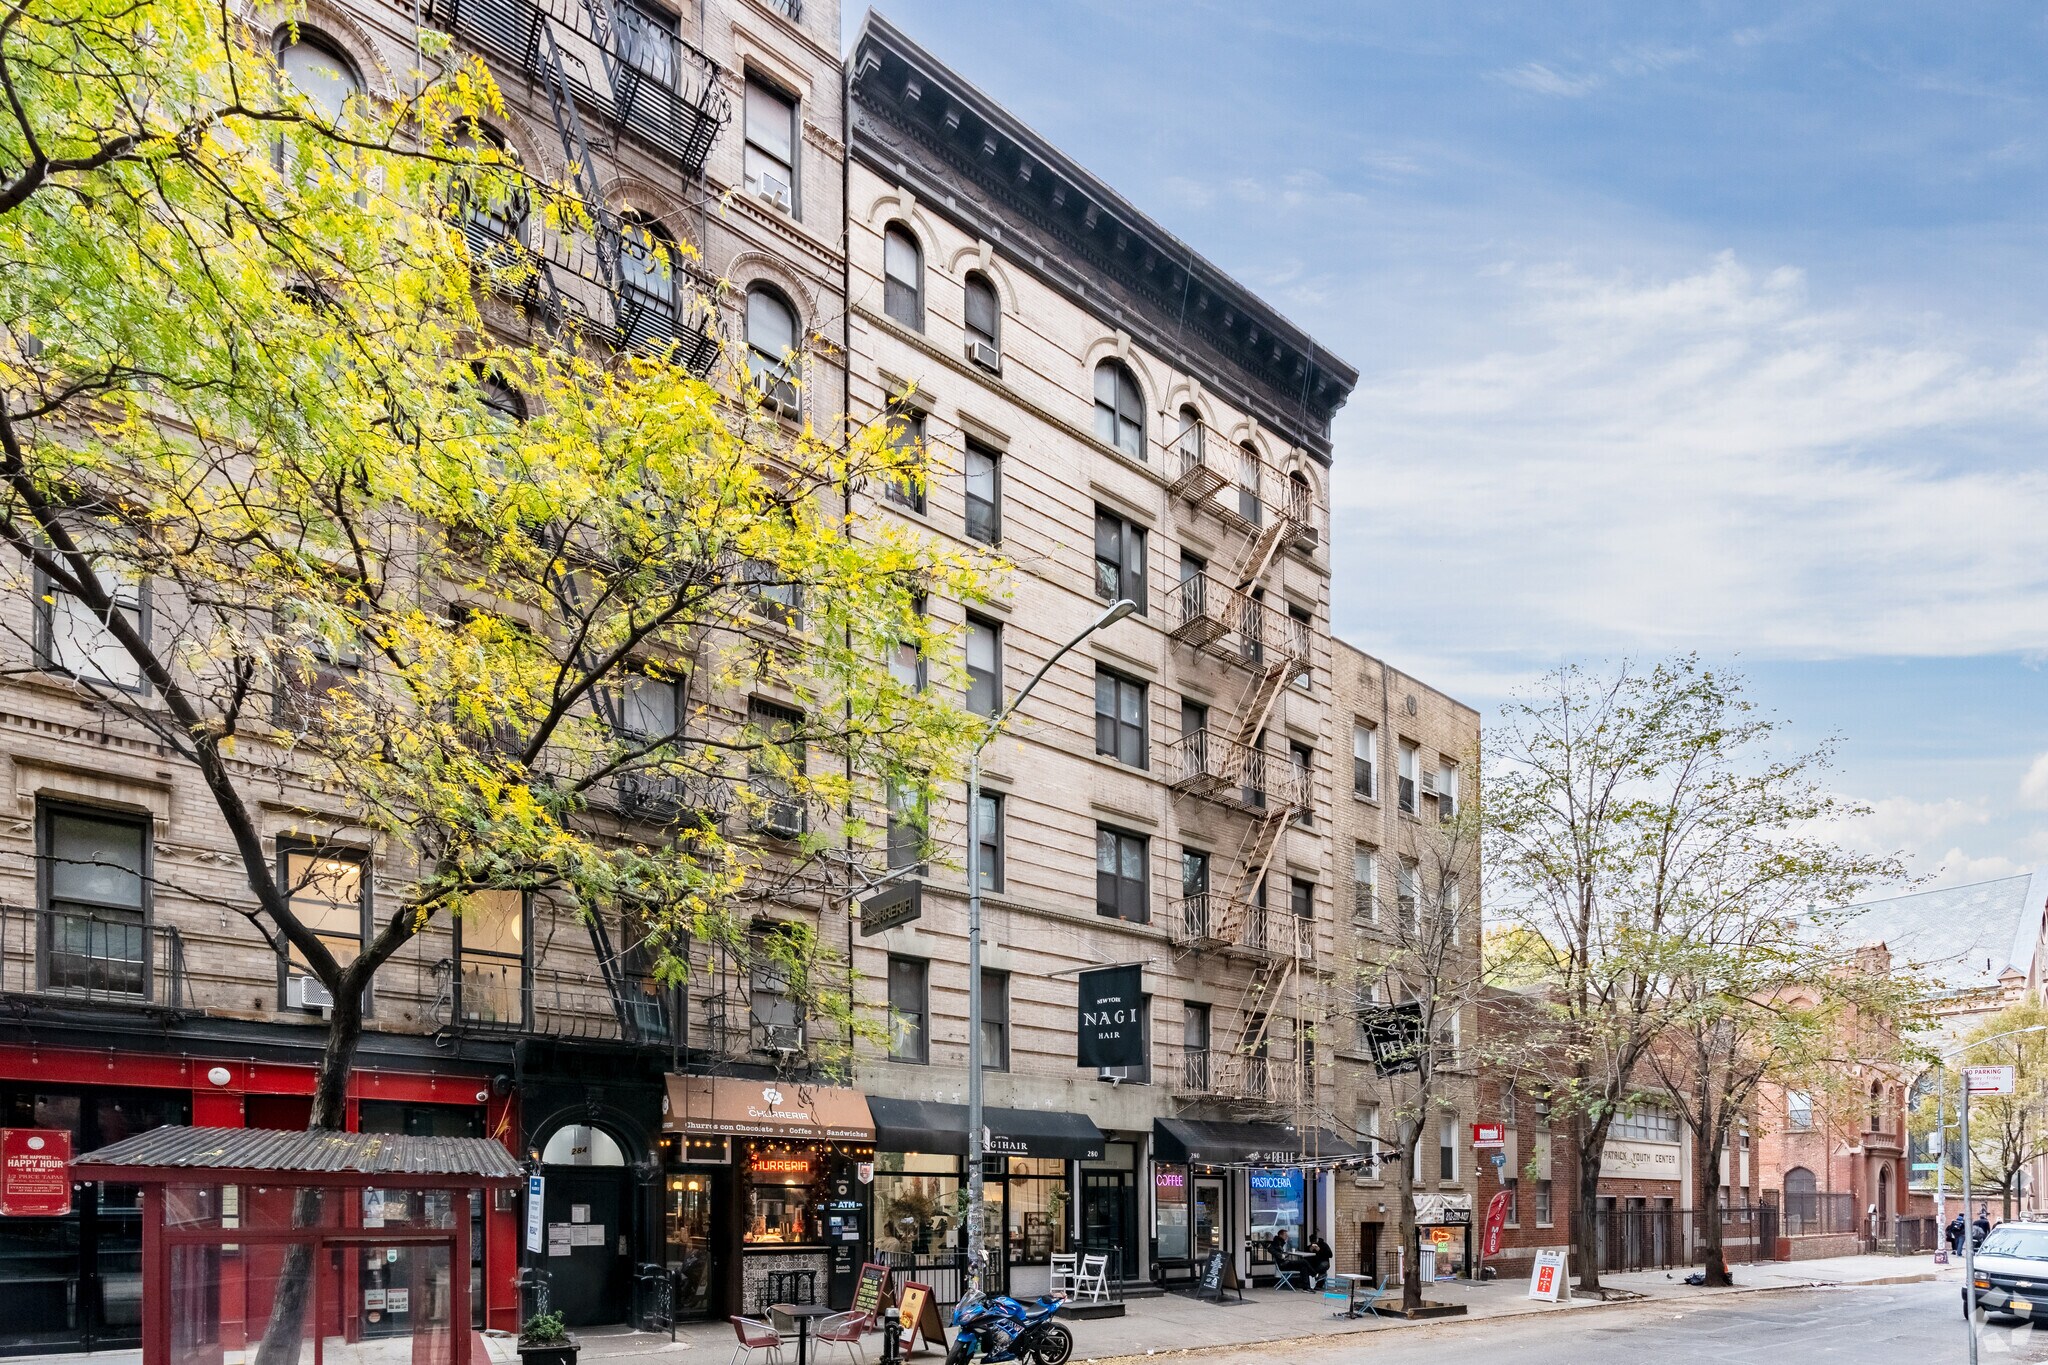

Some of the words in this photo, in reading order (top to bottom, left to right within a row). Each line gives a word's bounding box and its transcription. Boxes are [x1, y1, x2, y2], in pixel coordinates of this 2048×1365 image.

[1083, 1008, 1137, 1026] NAGI
[1098, 1031, 1120, 1039] HAIR
[748, 1109, 809, 1120] CHURRERIA
[789, 1127, 812, 1135] Coffee
[826, 1129, 868, 1138] Sandwiches
[571, 1147, 587, 1155] 284
[1271, 1151, 1295, 1163] BELLE
[1603, 1150, 1628, 1161] PATRICK
[1632, 1152, 1651, 1162] YOUTH
[1655, 1154, 1676, 1164] CENTER
[7, 1159, 38, 1168] HAPPY
[40, 1160, 64, 1168] HOUR
[1156, 1174, 1184, 1187] COFFEE
[1251, 1177, 1292, 1188] PASTICCERIA
[367, 1192, 381, 1206] A
[837, 1201, 856, 1209] ATM
[1490, 1226, 1500, 1252] MADE
